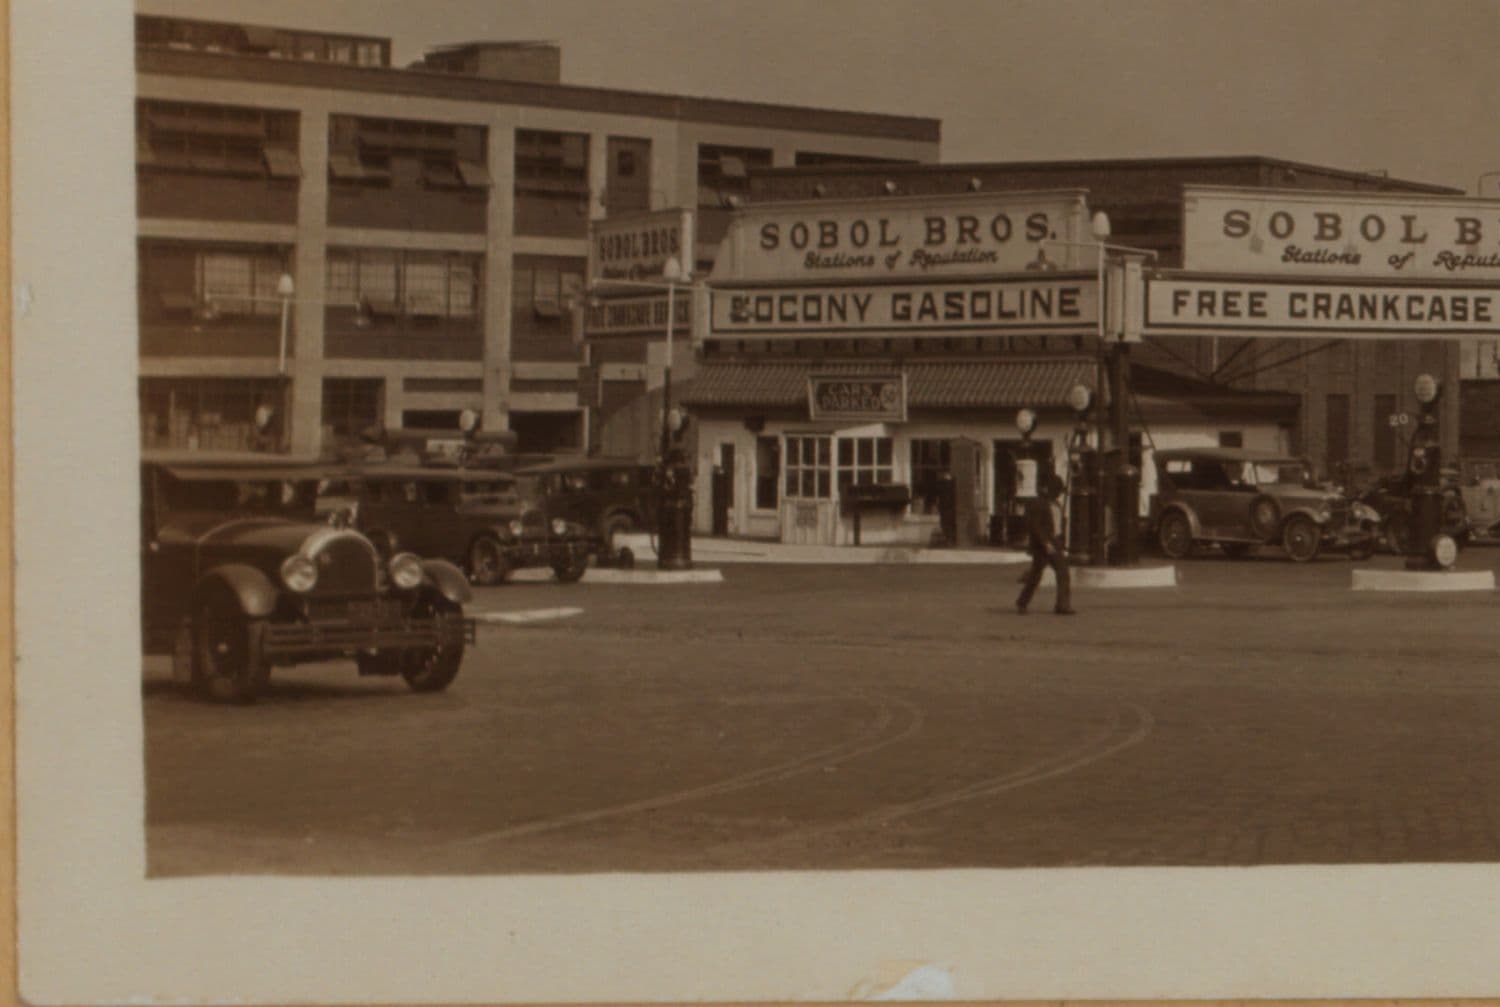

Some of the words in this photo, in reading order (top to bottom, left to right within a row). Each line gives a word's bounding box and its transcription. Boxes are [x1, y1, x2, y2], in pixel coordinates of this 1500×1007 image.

[759, 219, 900, 250] SOBOL
[925, 212, 1057, 245] BROS.
[1222, 209, 1428, 245] SOBOL
[804, 249, 875, 270] Stations
[884, 250, 904, 271] of
[910, 248, 999, 271] Reputation
[1281, 244, 1361, 266] Stations
[1388, 250, 1414, 270] of
[730, 294, 873, 325] SOCONY
[891, 287, 1081, 322] GASOLINE
[1172, 290, 1267, 319] FREE
[1289, 293, 1492, 323] CRANKCASE
